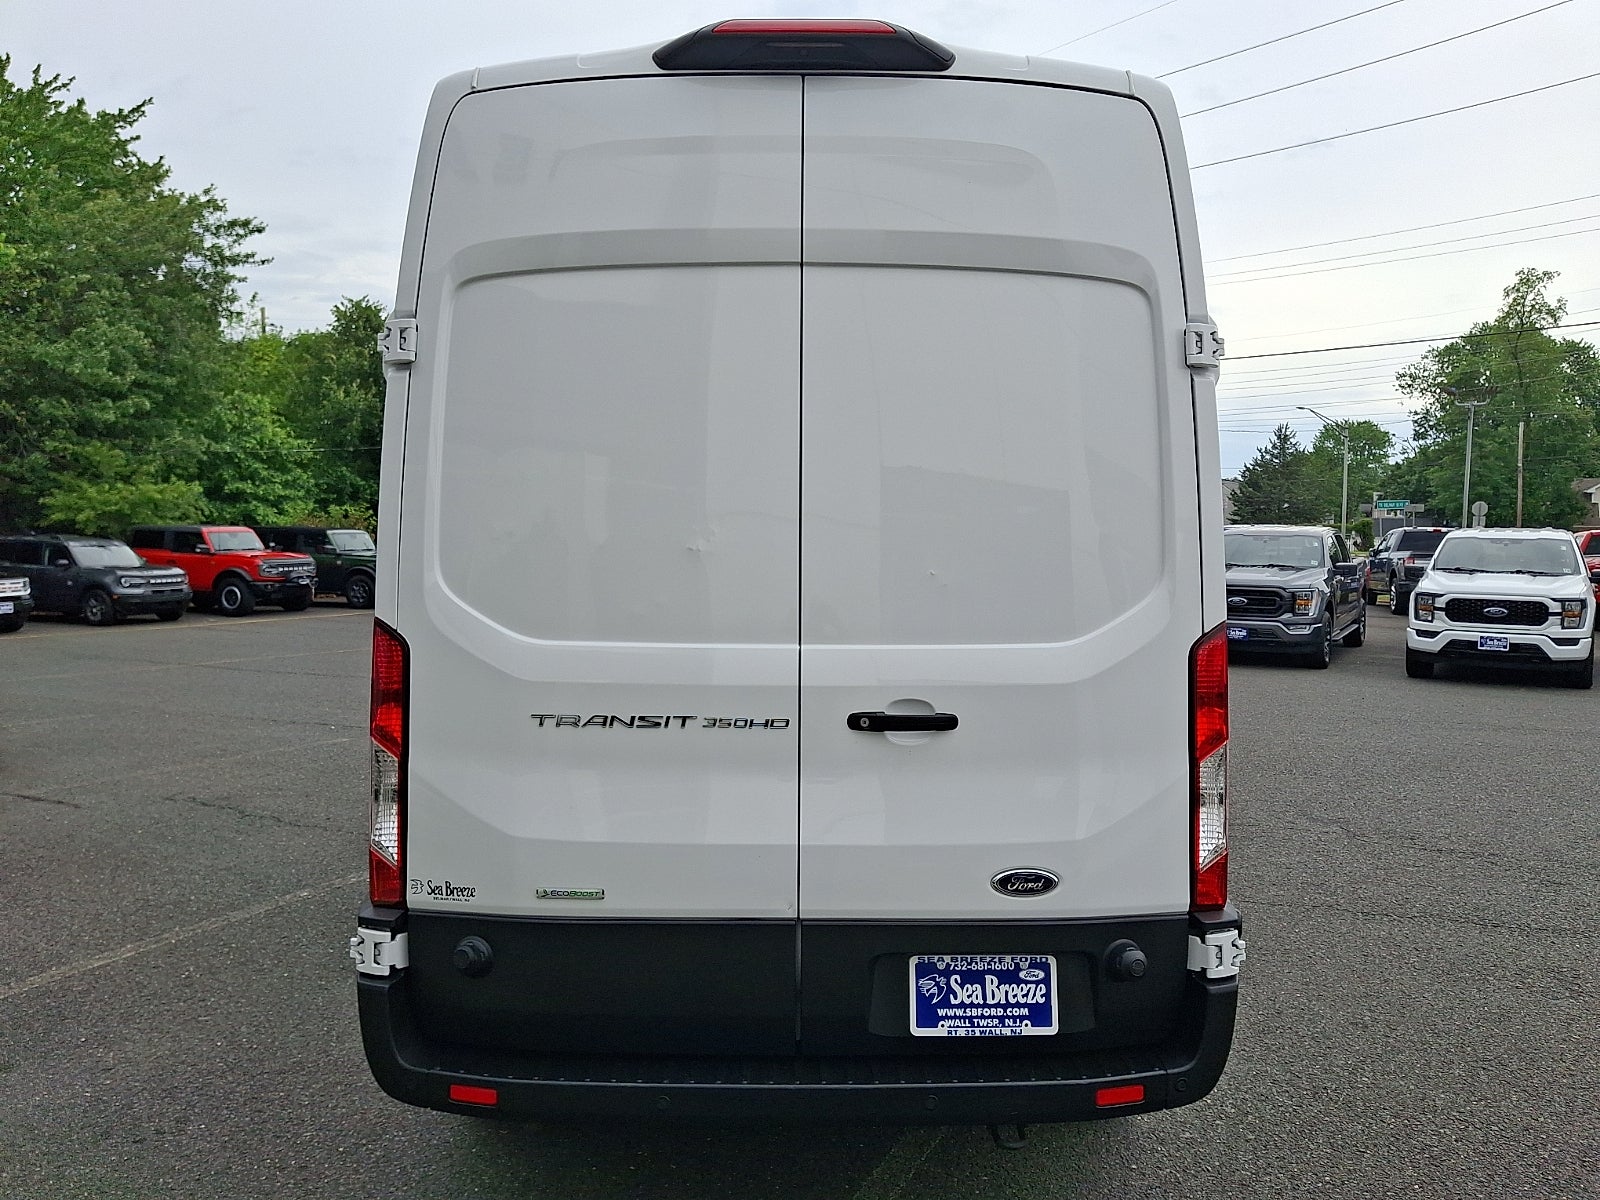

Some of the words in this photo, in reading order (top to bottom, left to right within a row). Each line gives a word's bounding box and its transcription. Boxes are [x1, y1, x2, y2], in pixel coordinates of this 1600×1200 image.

[530, 714, 697, 729] TRANSIT
[702, 717, 790, 730] 350HD
[427, 880, 443, 896] Sea
[444, 880, 476, 898] Breeze
[949, 962, 1015, 971] 732-681-1600
[949, 974, 985, 1005] Sea
[984, 974, 1046, 1004] Breeze
[937, 1007, 1029, 1017] WWW.SBFORD.COM
[945, 1018, 971, 1027] WALL
[1004, 1018, 1022, 1027] N.J.
